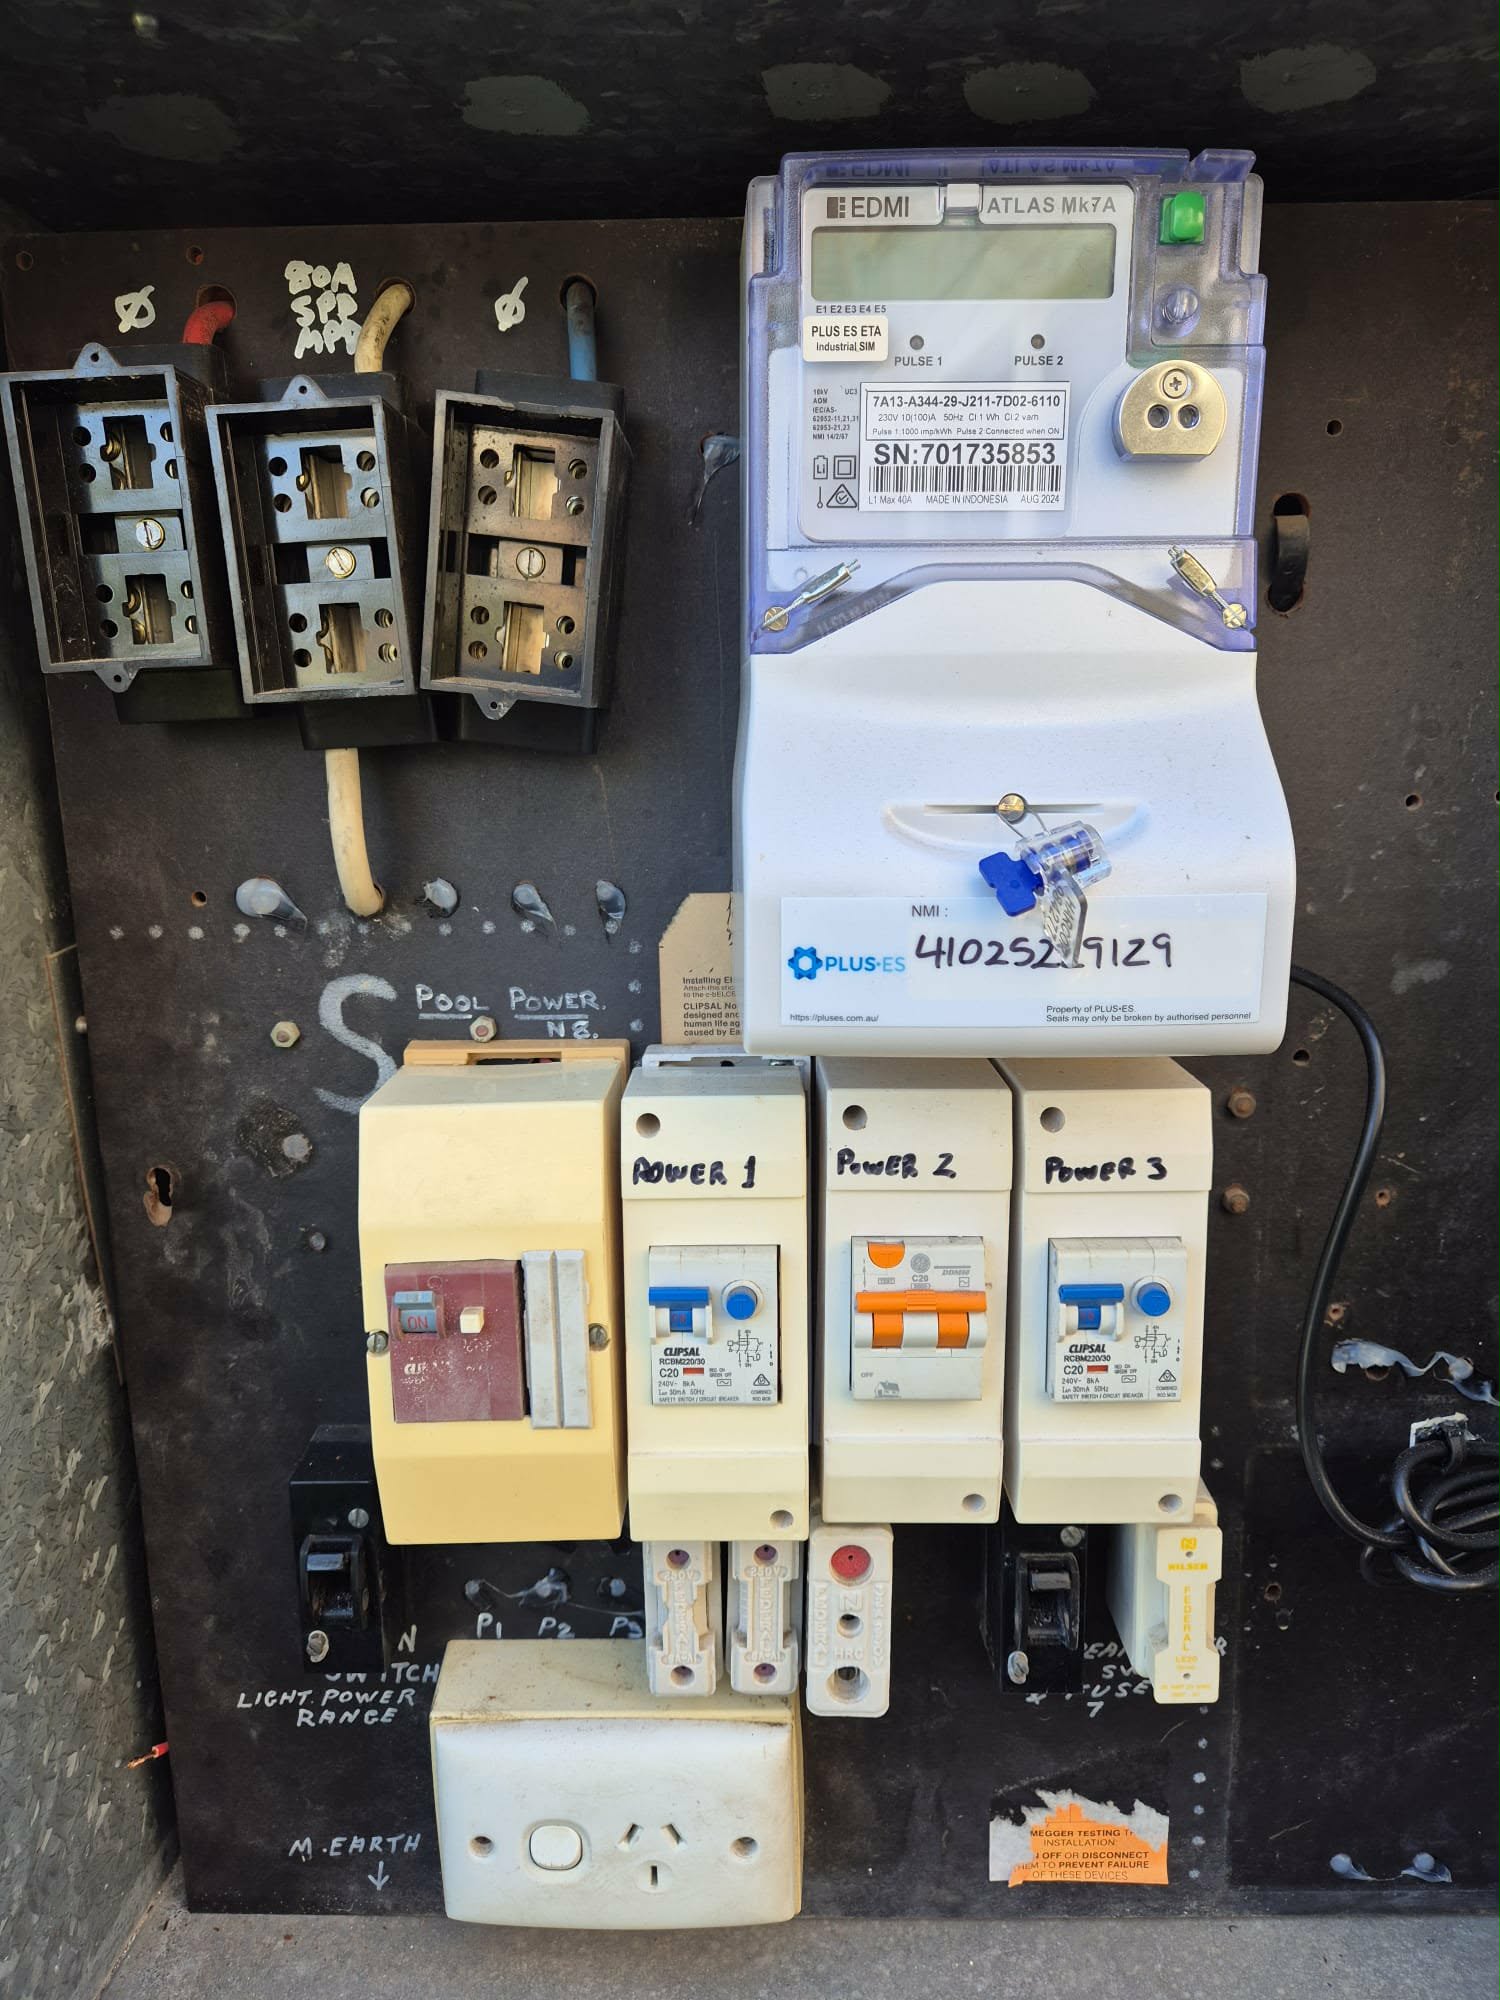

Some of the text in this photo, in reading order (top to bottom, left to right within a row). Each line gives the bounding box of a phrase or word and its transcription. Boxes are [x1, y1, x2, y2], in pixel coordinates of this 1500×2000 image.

[851, 196, 909, 218] EDMI
[987, 196, 1116, 213] ATLAS Mk7A
[816, 305, 886, 313] E1 E2 E3 E4 E5
[812, 325, 881, 337] PLUS ES ETA
[816, 342, 875, 352] Industrial SIM
[894, 356, 942, 366] PULSE 1
[1015, 356, 1063, 365] PULSE 2
[874, 395, 1060, 407] 7A13-A344-29-J211-7D02-6110
[878, 414, 898, 422] 230V
[901, 414, 936, 422] 10(100)A
[944, 414, 963, 422] 50Hz
[874, 443, 1056, 465] SN:701735853
[880, 496, 895, 505] Max
[897, 496, 912, 504] 40A
[926, 495, 950, 504] MADE
[952, 495, 960, 504] IN
[962, 495, 1008, 504] INDONESIA
[1021, 495, 1040, 503] AUG
[1041, 495, 1059, 503] 2024
[912, 905, 939, 917] NMI
[914, 933, 1172, 969] 4102529129
[683, 977, 721, 985] Installing
[415, 983, 489, 1012] POOL
[1047, 1006, 1081, 1014] Property
[1084, 1005, 1092, 1013] of
[790, 1014, 879, 1022] https://pluses.com.au/
[1071, 1015, 1089, 1023] may
[1092, 1014, 1108, 1023] only
[1111, 1014, 1121, 1022] be
[1154, 1014, 1164, 1022] by
[1166, 1013, 1209, 1021] authorised
[1211, 1012, 1251, 1021] personnel
[717, 1028, 726, 1036] by
[932, 1153, 957, 1179] 2
[1147, 1157, 1168, 1180] 3
[741, 1155, 756, 1189] 1
[663, 1347, 700, 1356] CLIPSAL
[1069, 1344, 1106, 1353] CLIPSAL
[659, 1368, 679, 1378] C20
[1064, 1365, 1083, 1375] C20
[321, 1688, 416, 1707] POWER
[297, 1707, 398, 1727] RANGE
[1059, 1861, 1105, 1869] PREVENT
[1032, 1871, 1128, 1880] OF THESE DEVICES
